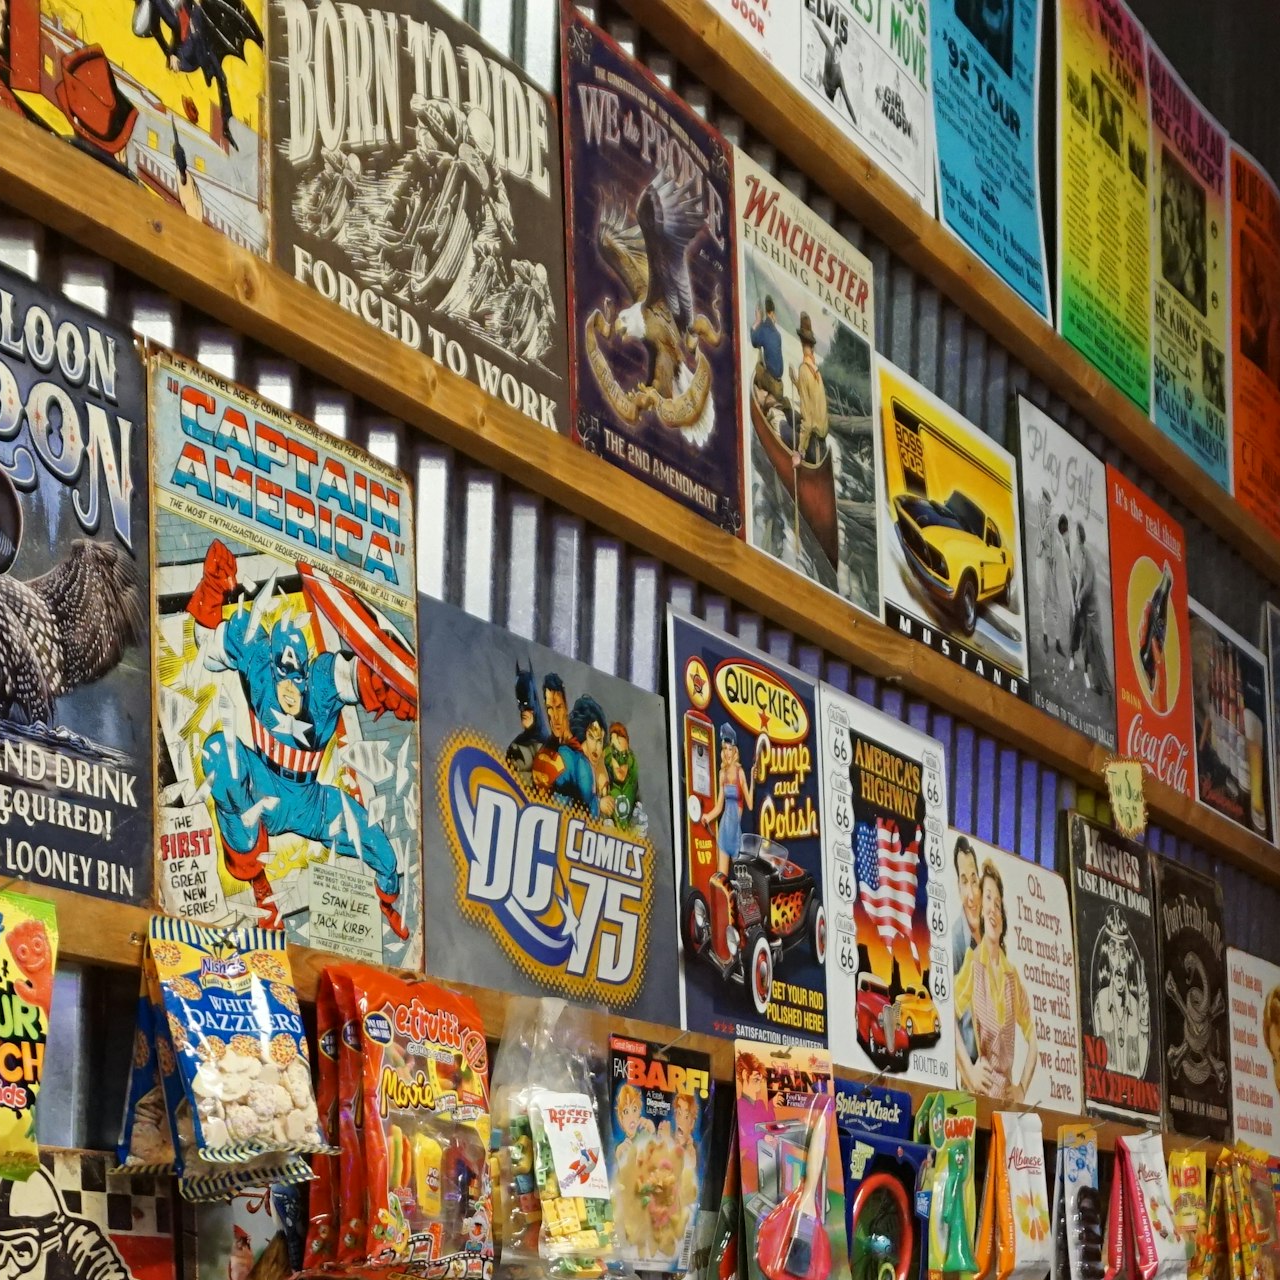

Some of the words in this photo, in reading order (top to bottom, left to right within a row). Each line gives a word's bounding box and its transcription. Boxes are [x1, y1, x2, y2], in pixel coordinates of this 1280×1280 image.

[280, 0, 403, 165] BORN
[403, 15, 462, 110] TO
[456, 42, 552, 198] RIDE
[744, 173, 871, 314] WINCHESTER
[743, 222, 811, 288] FISHING
[813, 280, 871, 337] TACKLE
[0, 287, 118, 402] LOON
[293, 244, 421, 350] FORCED
[428, 325, 468, 379] TO
[474, 354, 559, 433] WORK
[604, 428, 626, 458] THE
[627, 443, 650, 472] 2ND
[652, 458, 718, 513] AMENDMENT
[1114, 482, 1129, 507] It's
[1130, 494, 1145, 519] the
[1146, 507, 1162, 535] real
[1163, 521, 1183, 563] thing
[898, 617, 1019, 696] MUSTANG
[724, 664, 802, 735] QUICKIES
[758, 737, 811, 780] Pump
[854, 738, 921, 793] AMERICA'S
[1126, 713, 1190, 796] Coca-Cola
[54, 753, 138, 808] DRINK
[773, 778, 799, 796] and
[860, 772, 919, 822] HIGHWAY
[759, 798, 820, 840] Polish
[159, 828, 213, 861] FIRST
[466, 787, 560, 911] DC
[565, 821, 646, 881] COMICS
[6, 837, 93, 889] LOONEY
[97, 859, 135, 897] BIN
[171, 870, 208, 889] GREAT
[1027, 873, 1046, 903] Oh,
[178, 893, 218, 917] SERIES!
[183, 887, 208, 902] NEW
[321, 892, 349, 909] STAN
[1016, 896, 1034, 924] I'm
[1035, 909, 1062, 935] sorry.
[313, 914, 338, 930] JACK
[564, 867, 642, 983] 75
[1014, 926, 1033, 955] You
[1036, 940, 1061, 964] must
[1062, 943, 1073, 968] be
[1023, 962, 1071, 997] confusing
[1032, 993, 1047, 1013] me
[1049, 996, 1072, 1020] with
[1035, 1016, 1052, 1038] the
[1054, 1028, 1077, 1049] maid
[627, 1060, 710, 1099] BARF!
[1039, 1052, 1053, 1070] we
[1054, 1052, 1077, 1077] don't
[1049, 1074, 1074, 1102] have.
